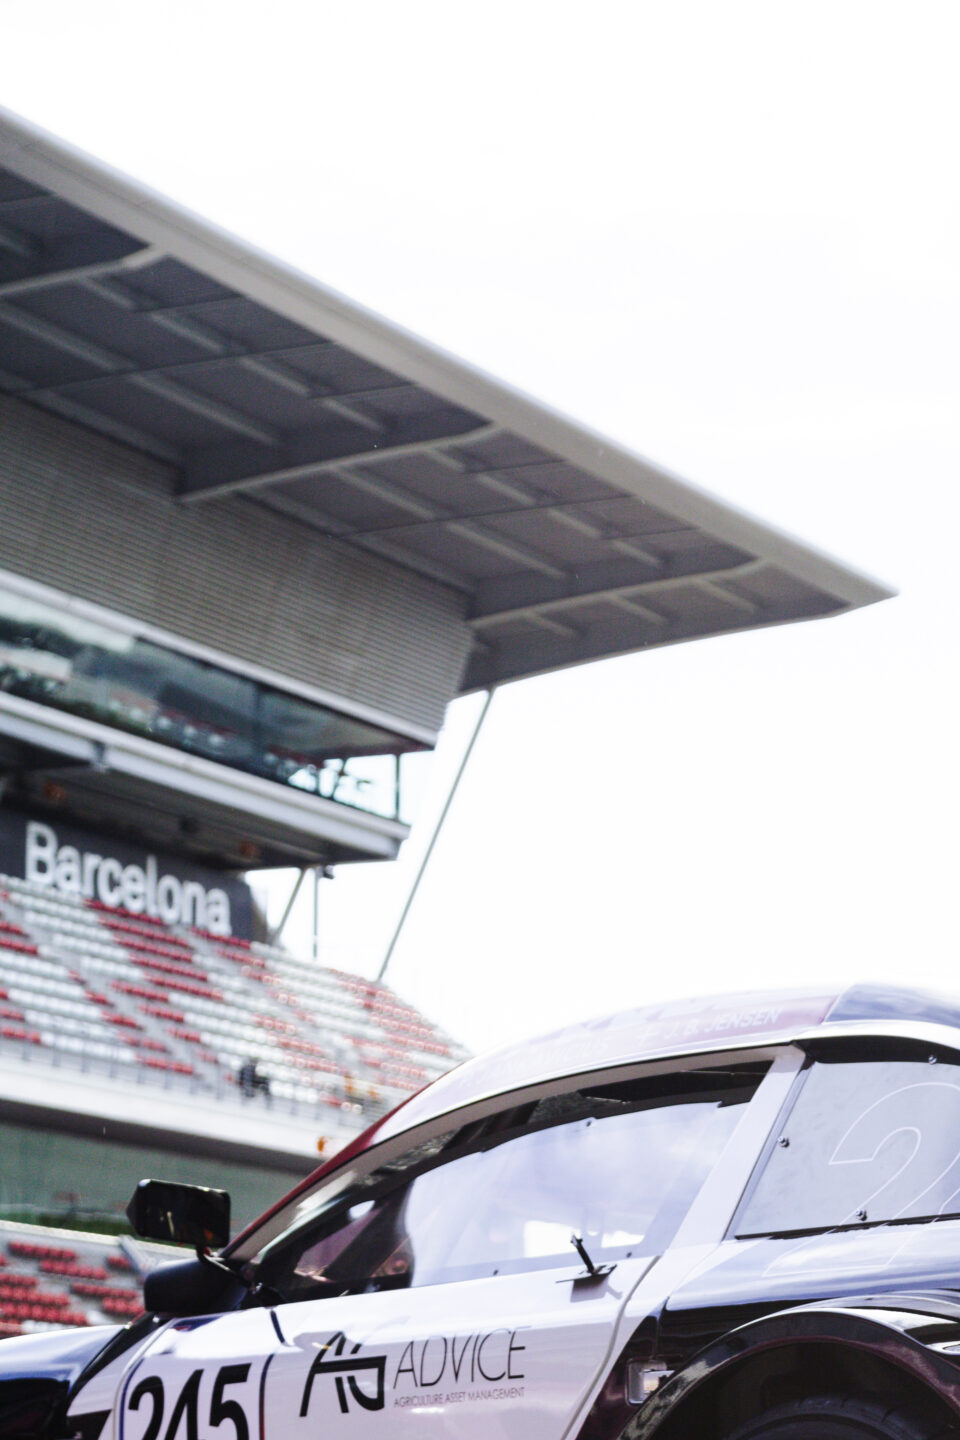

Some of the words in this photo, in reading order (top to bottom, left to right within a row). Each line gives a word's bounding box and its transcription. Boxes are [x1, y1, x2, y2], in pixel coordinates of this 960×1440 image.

[26, 821, 232, 936] Barcelona
[704, 1008, 782, 1033] JENSEN
[393, 1326, 530, 1389] ADVICE
[393, 1393, 443, 1408] AGRICULTURE
[445, 1391, 466, 1403] ASSET
[468, 1387, 525, 1401] MANAGEMENT
